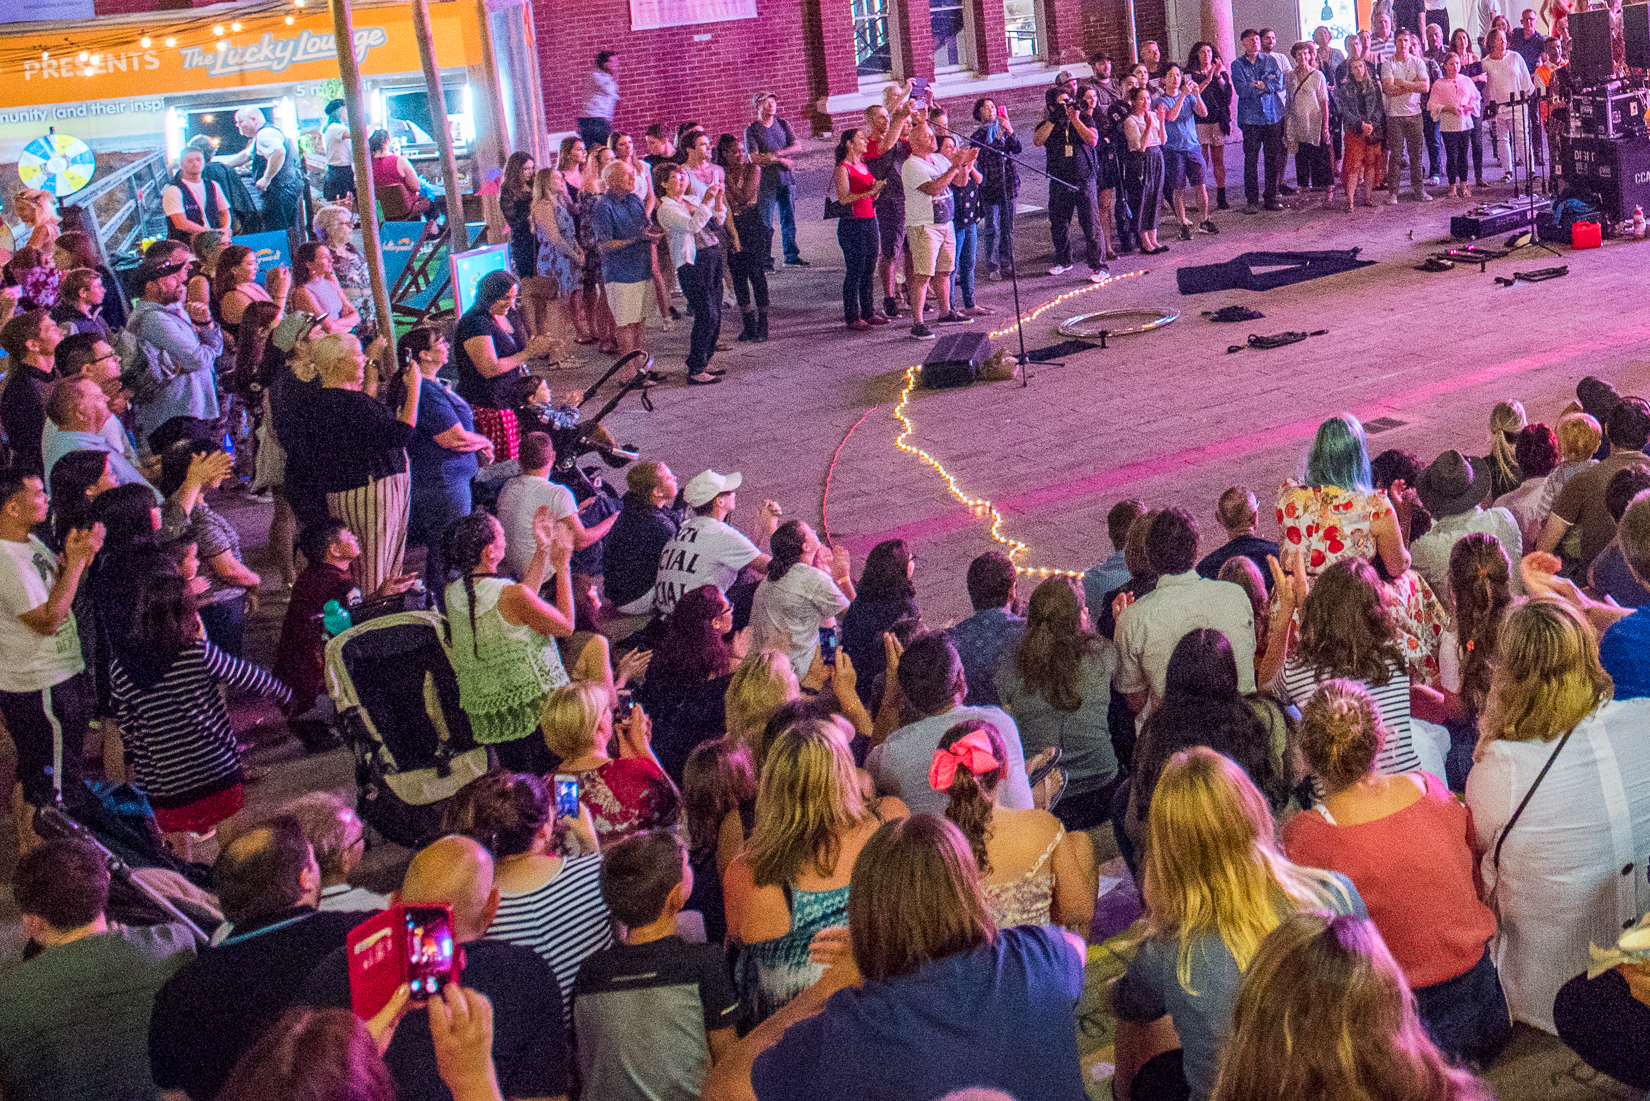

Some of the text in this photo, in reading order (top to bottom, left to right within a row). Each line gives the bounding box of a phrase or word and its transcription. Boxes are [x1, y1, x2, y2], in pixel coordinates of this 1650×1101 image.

[181, 28, 386, 76] The Lucky Louge
[23, 50, 161, 80] PRESENTS
[295, 85, 306, 97] 5
[52, 103, 87, 120] (and
[90, 100, 126, 116] their
